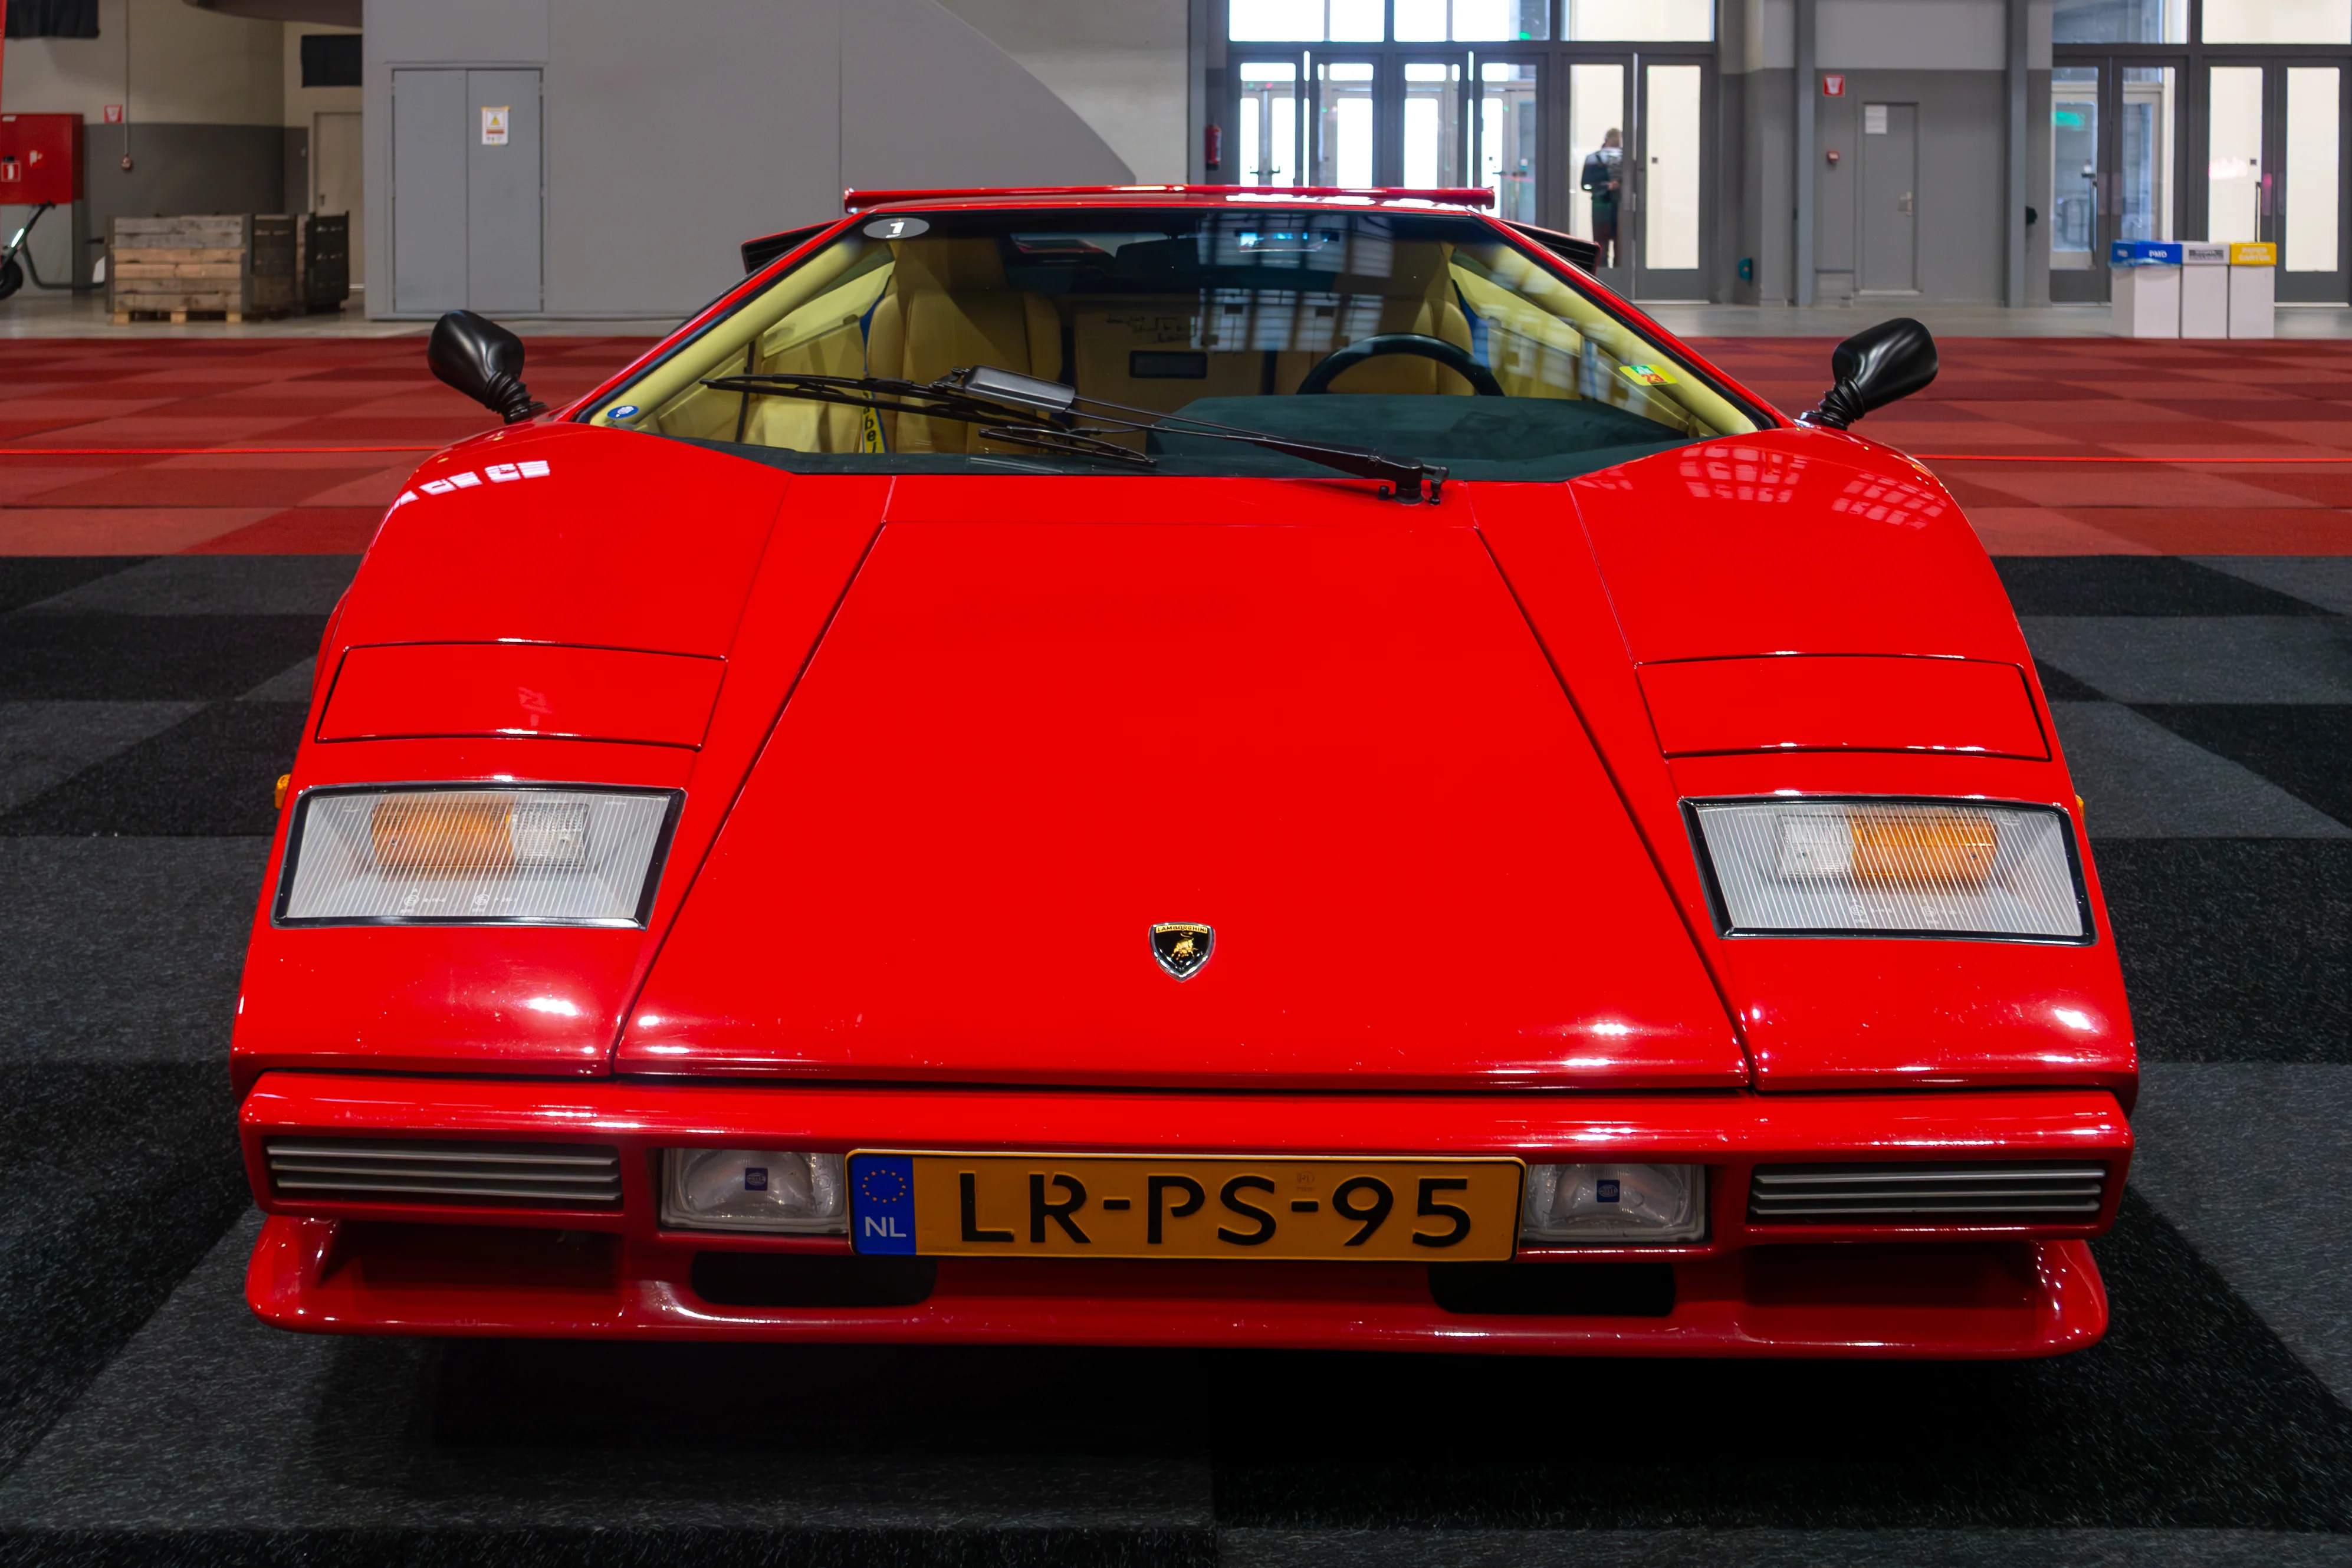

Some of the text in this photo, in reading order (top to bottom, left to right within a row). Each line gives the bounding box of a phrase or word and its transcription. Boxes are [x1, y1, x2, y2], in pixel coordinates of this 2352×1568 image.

[2149, 249, 2167, 258] PMD
[1641, 373, 1665, 383] 23
[959, 1172, 1471, 1248] LR-PS-95
[865, 1216, 907, 1237] NL
